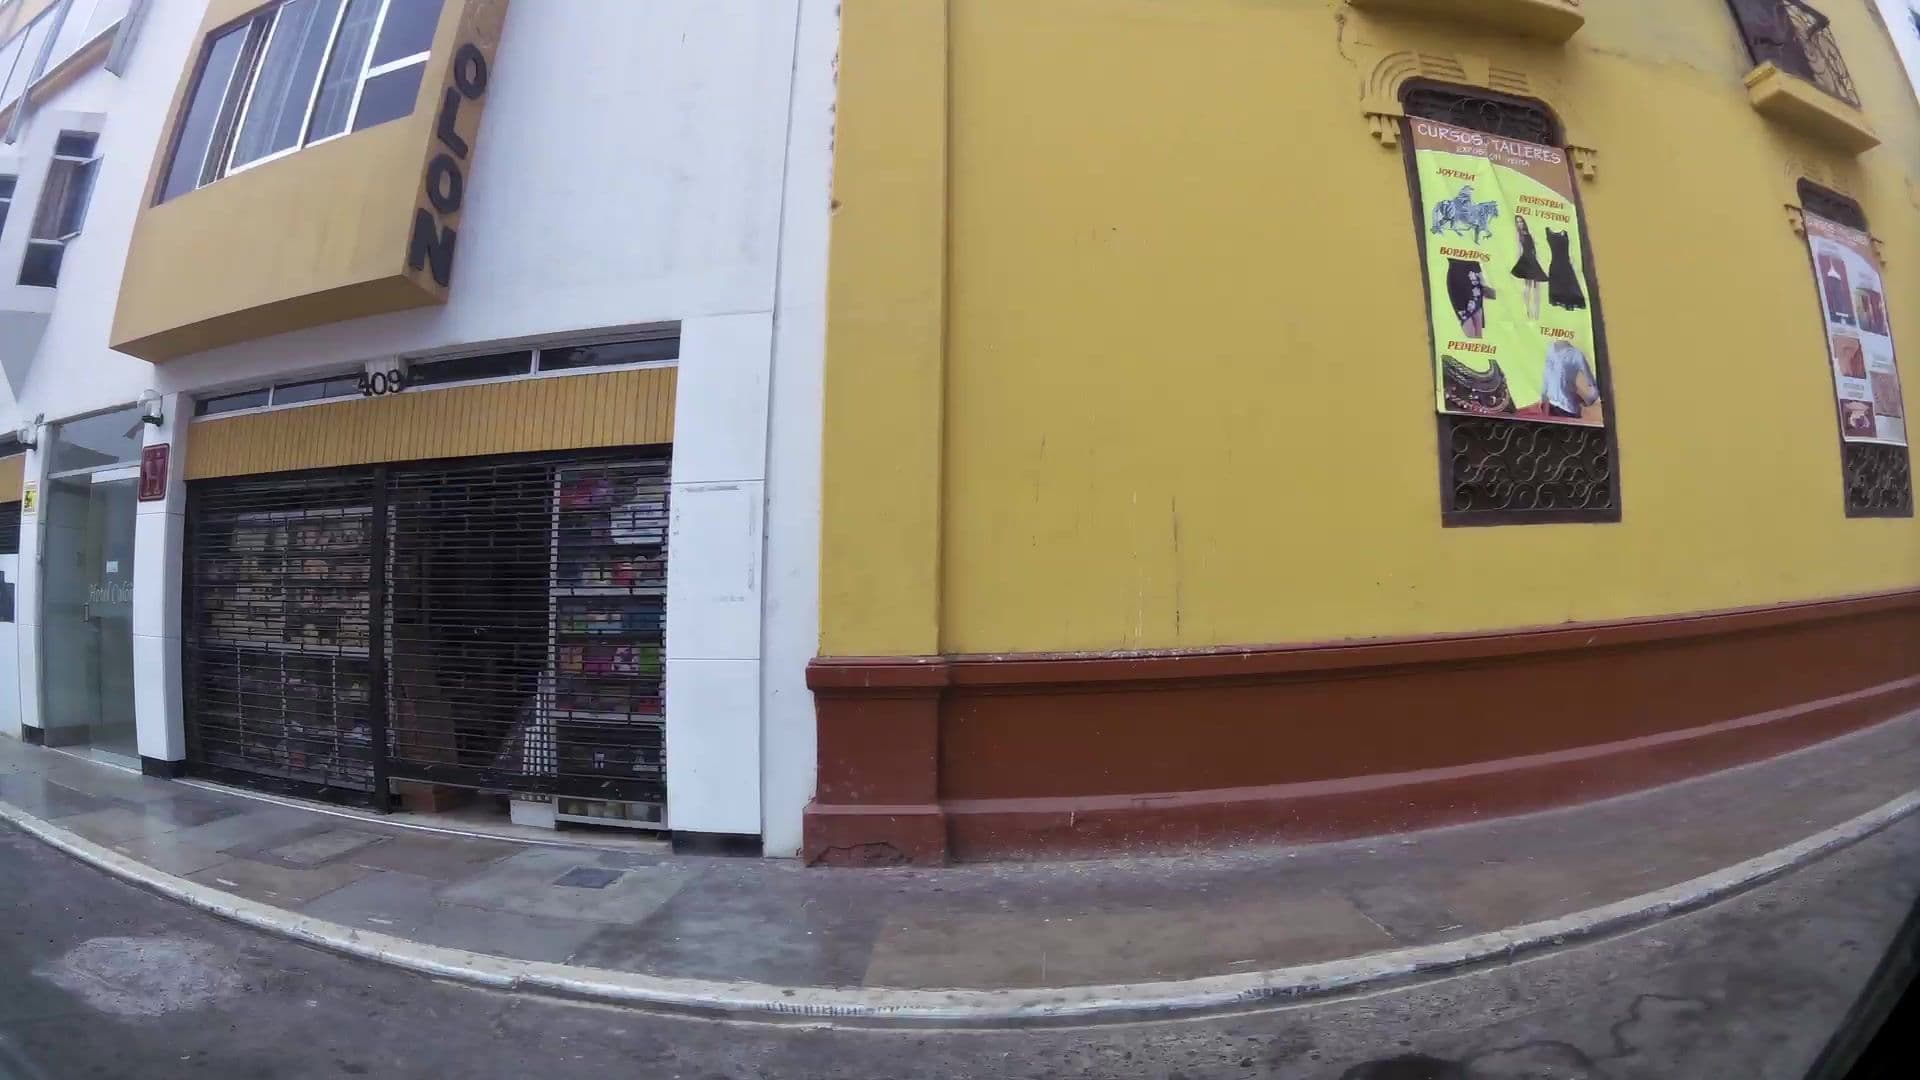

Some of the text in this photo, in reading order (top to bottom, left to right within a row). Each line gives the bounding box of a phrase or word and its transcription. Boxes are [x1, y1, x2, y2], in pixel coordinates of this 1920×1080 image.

[1417, 123, 1484, 146] CURSOS
[1491, 139, 1561, 164] TALLERES
[1519, 195, 1564, 210] INDUSTRIA
[1515, 206, 1532, 216] DEL
[1440, 246, 1490, 261] BORDADOS
[1540, 326, 1575, 339] TEJIDOS
[358, 369, 402, 396] 409
